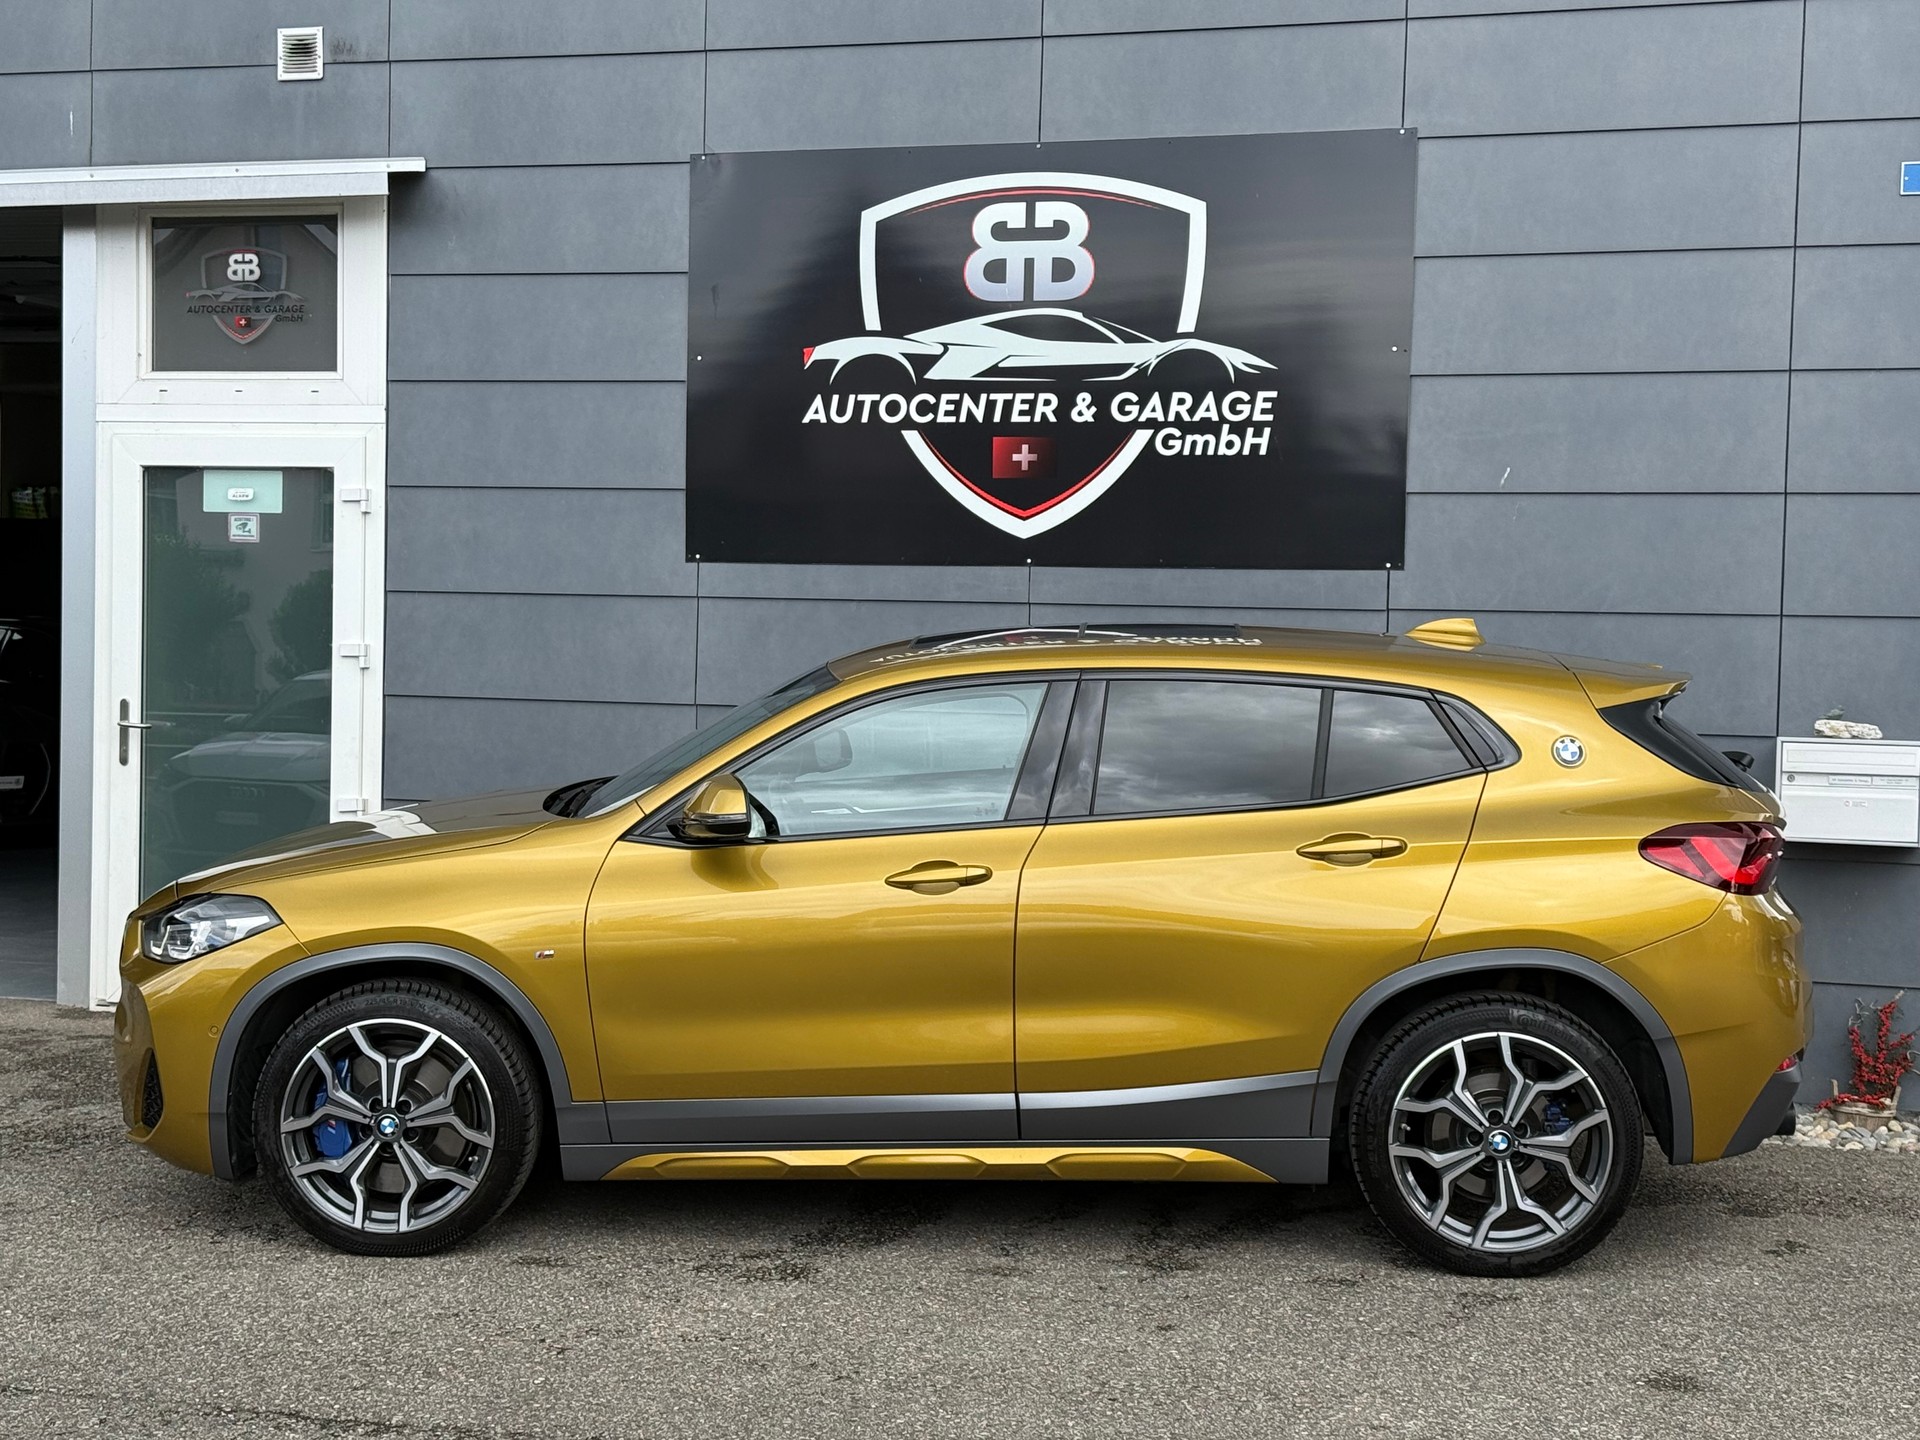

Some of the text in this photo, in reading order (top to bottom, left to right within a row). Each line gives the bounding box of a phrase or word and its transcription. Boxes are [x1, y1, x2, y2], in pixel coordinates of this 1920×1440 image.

[187, 304, 305, 314] AUTOCENTER & GARAGE
[275, 314, 303, 322] GmbH
[802, 390, 1279, 424] AUTOCENTER & GARAGE
[1154, 423, 1272, 457] GmbH
